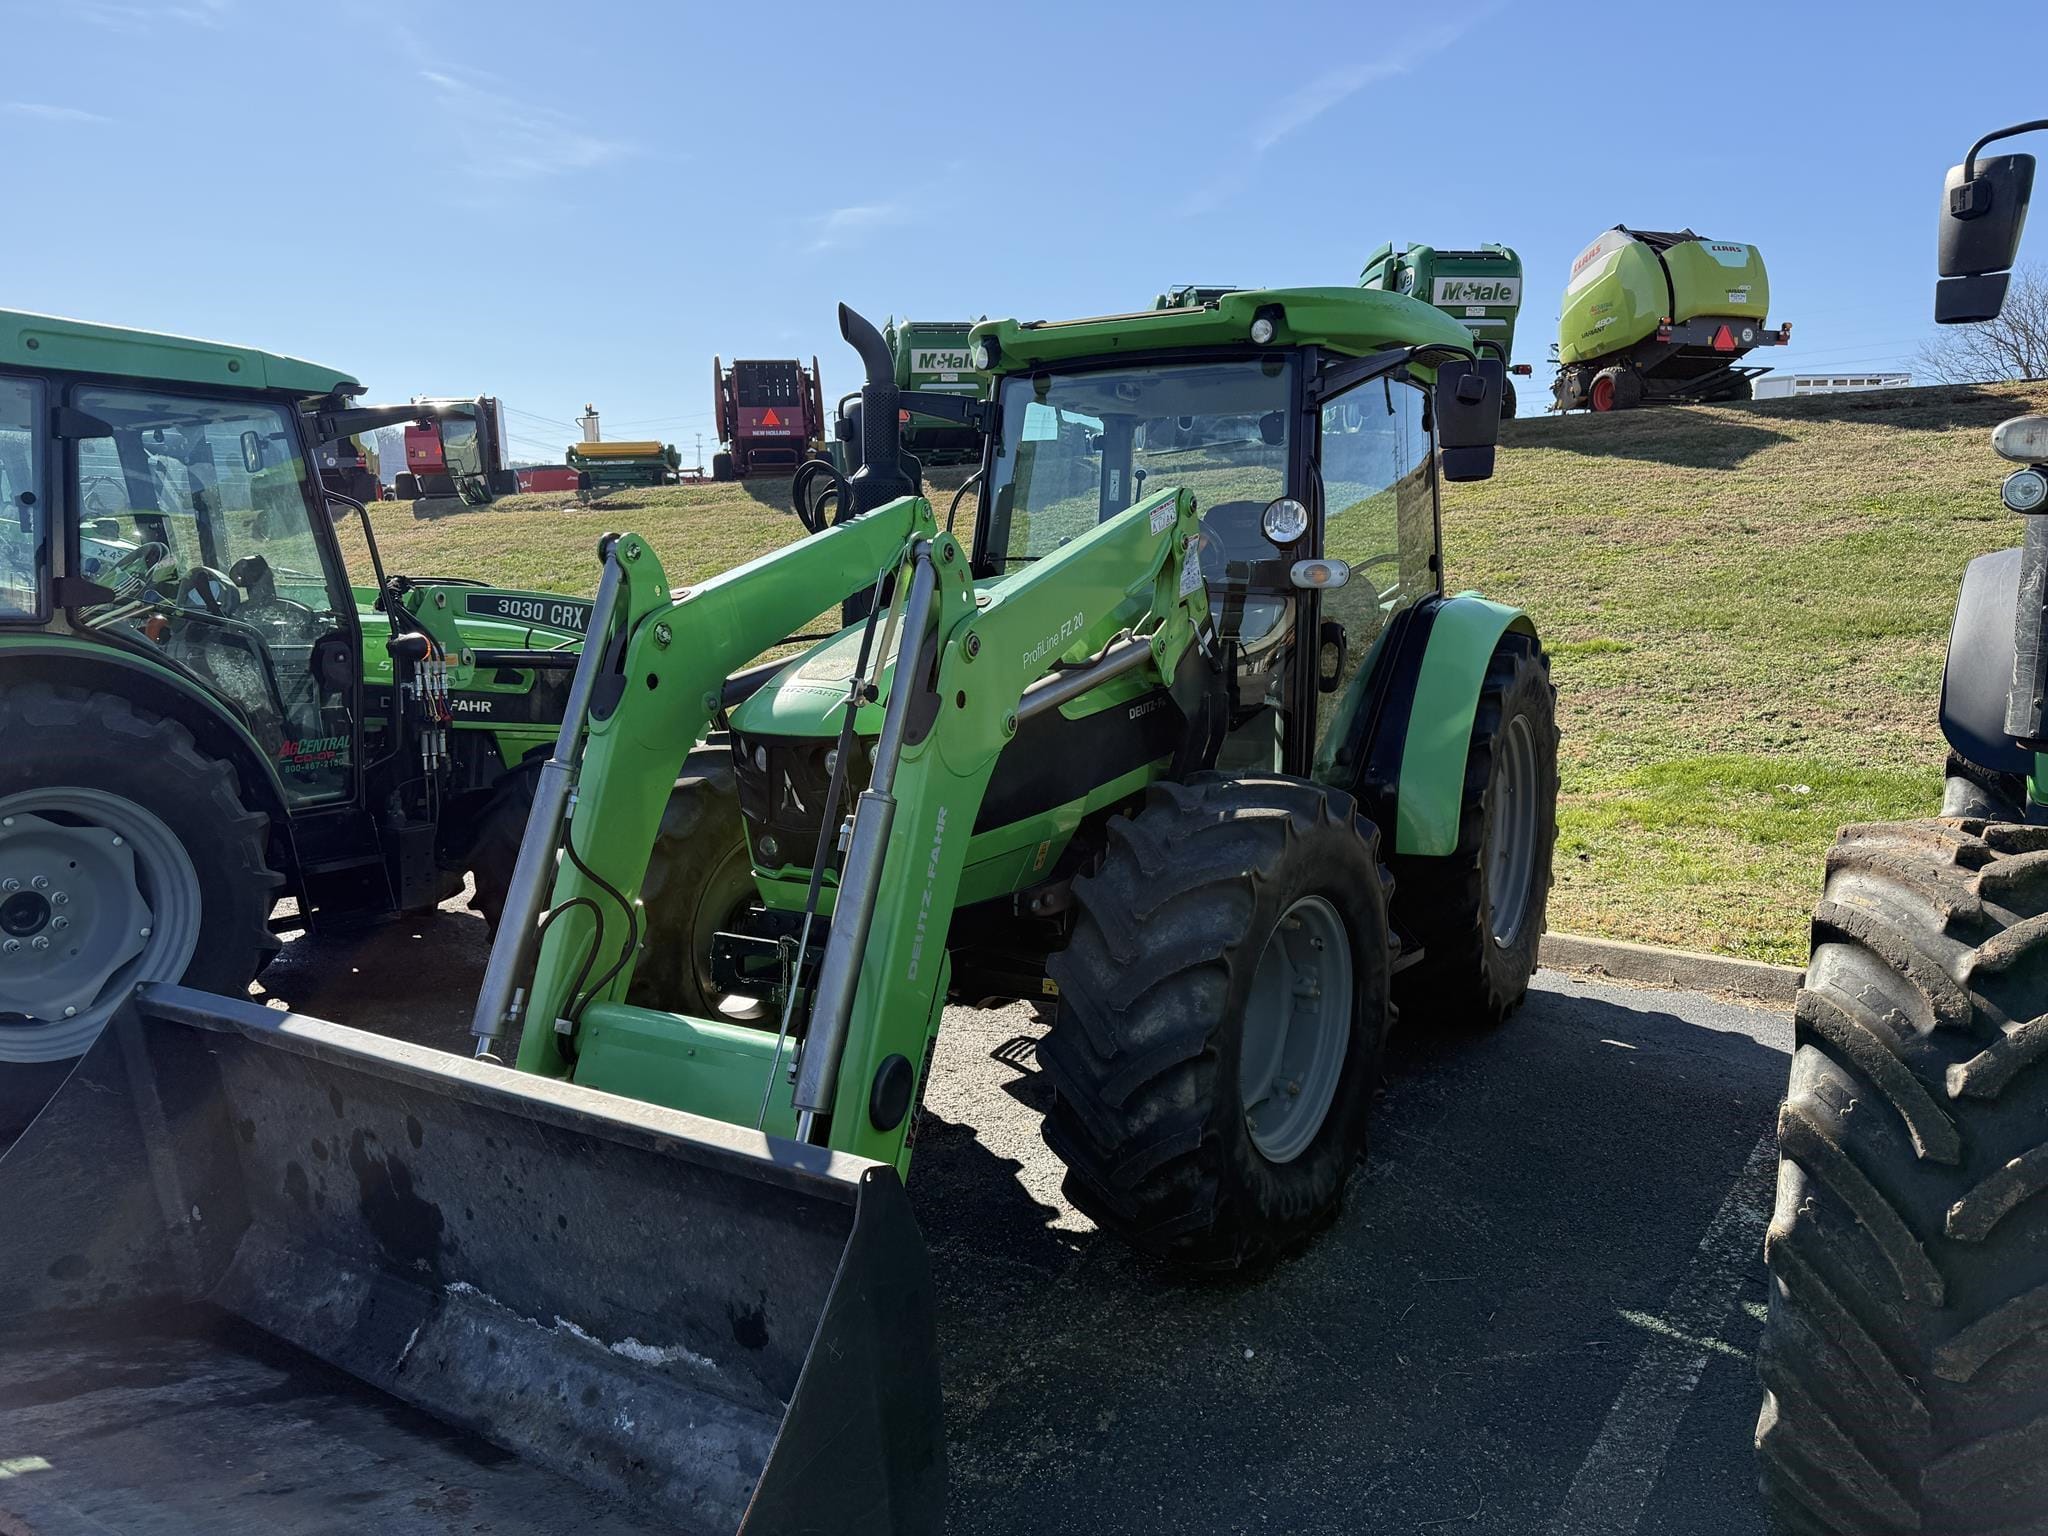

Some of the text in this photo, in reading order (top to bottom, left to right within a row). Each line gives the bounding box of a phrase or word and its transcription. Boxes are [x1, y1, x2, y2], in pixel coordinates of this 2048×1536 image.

[1573, 243, 1602, 273] CLAAS
[1711, 245, 1742, 253] CLAAS
[1441, 281, 1512, 301] McHale
[498, 599, 584, 630] 3030 CRX
[1023, 611, 1084, 670] ProfiLine FZ 20
[907, 805, 948, 981] DEUTZ-FAHR
